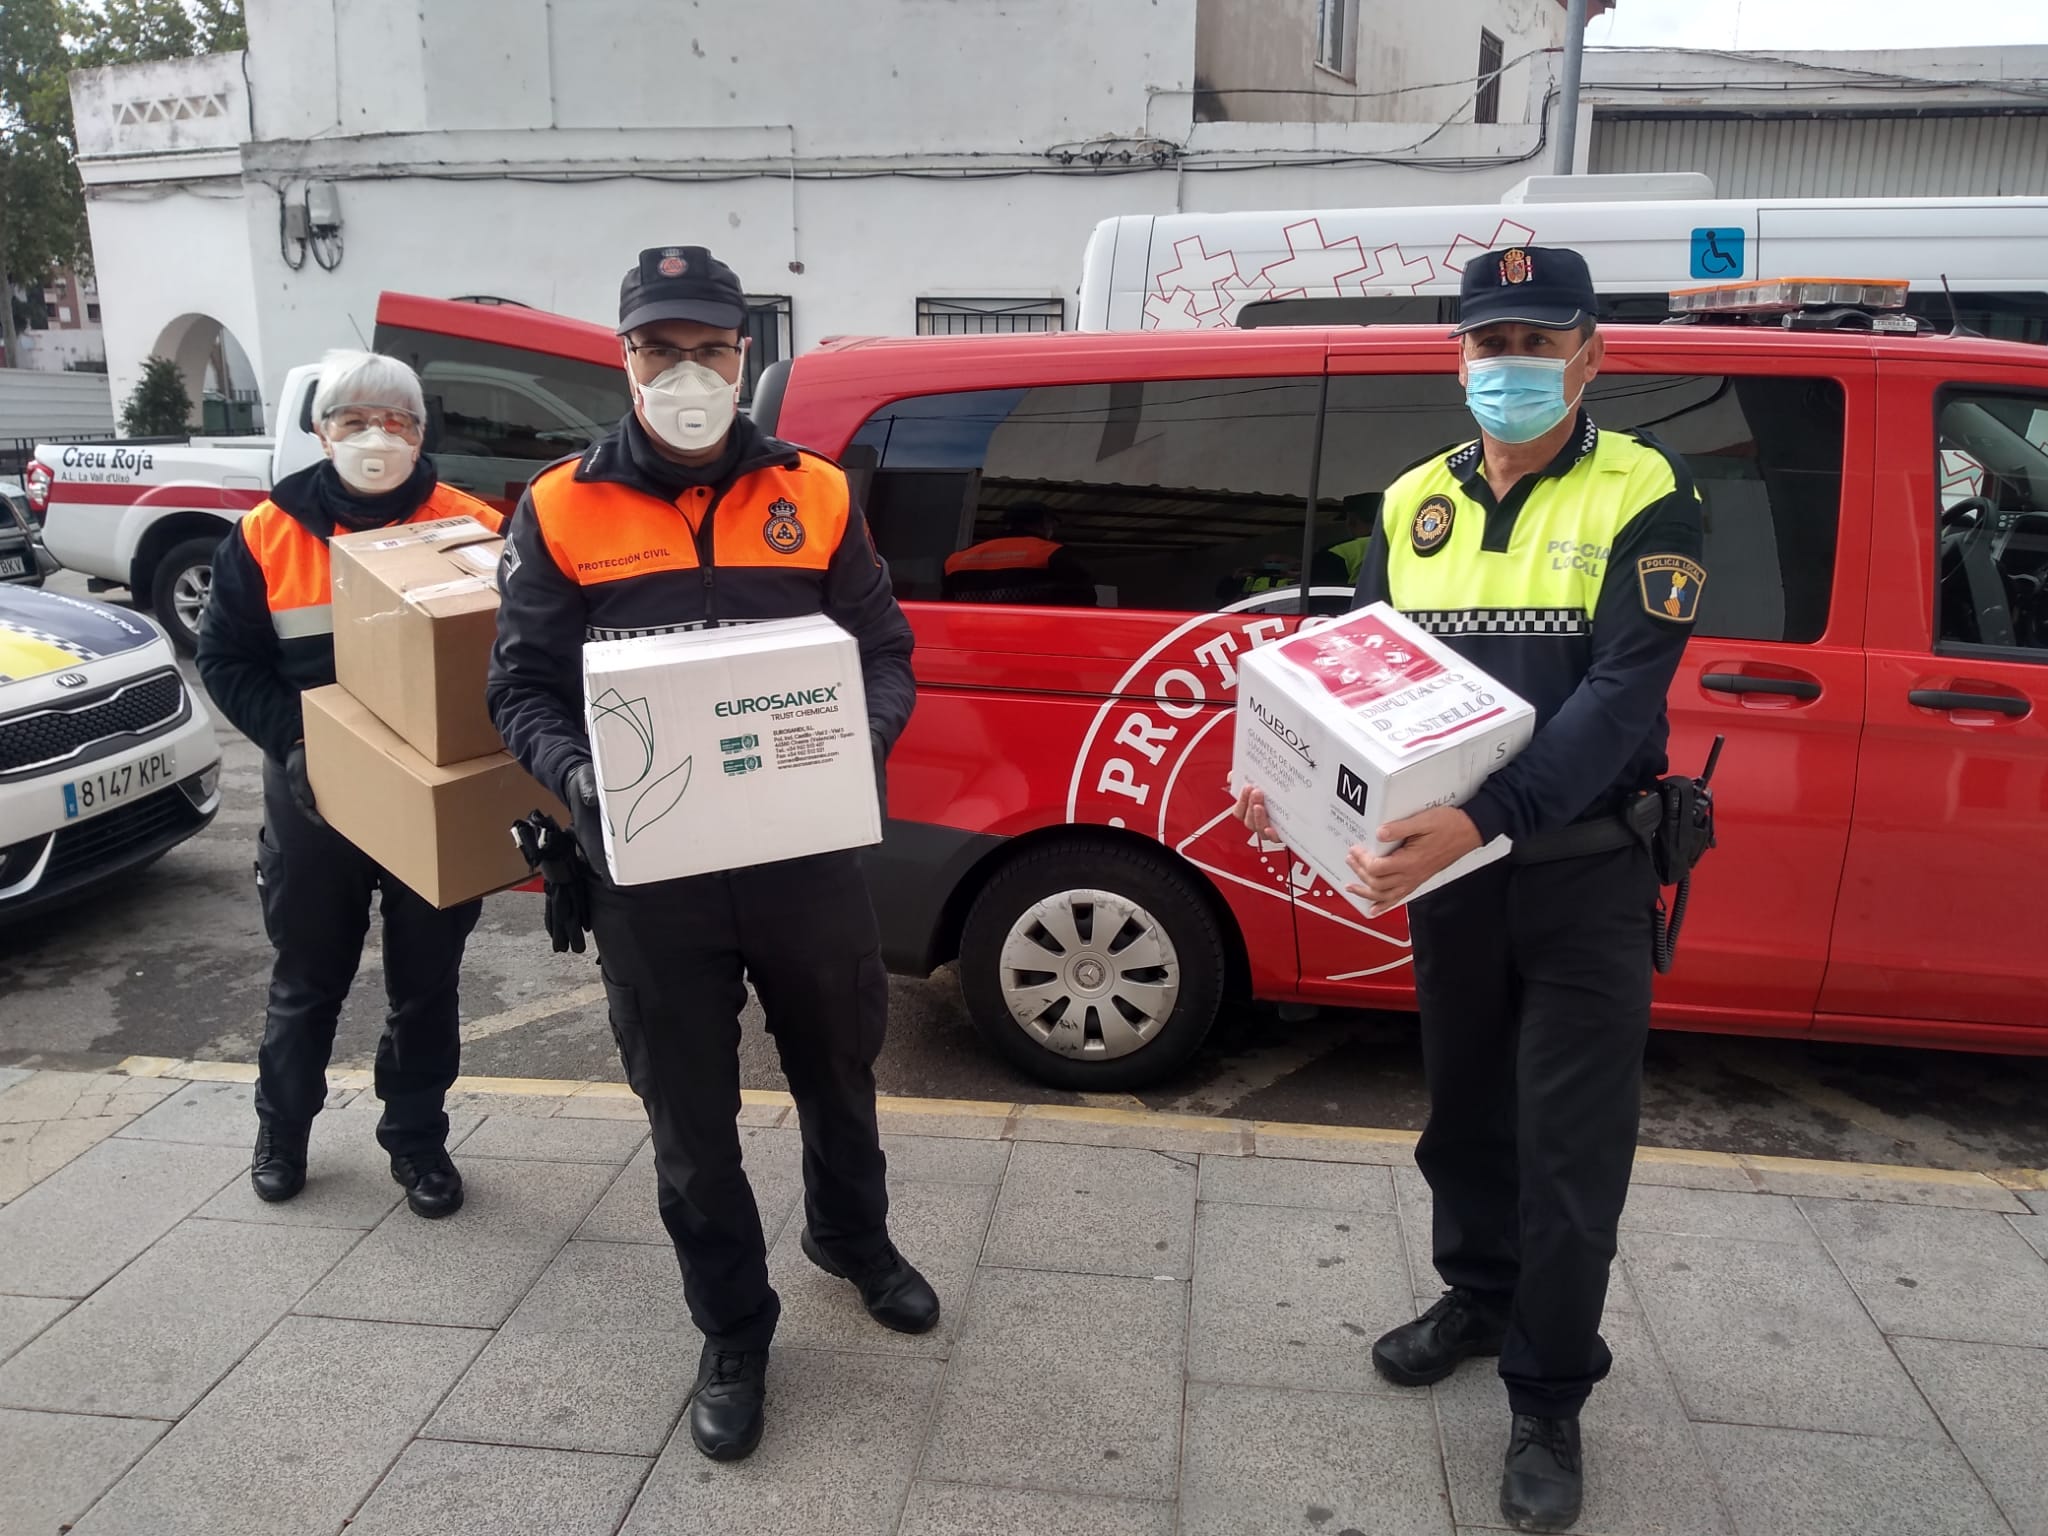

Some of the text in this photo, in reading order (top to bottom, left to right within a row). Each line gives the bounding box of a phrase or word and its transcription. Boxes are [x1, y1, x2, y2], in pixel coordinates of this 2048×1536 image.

[62, 447, 153, 476] Creu Roja
[78, 473, 87, 481] La
[90, 473, 103, 482] Vall
[643, 548, 671, 560] CIVIL
[1552, 556, 1599, 578] LOCAL
[1682, 562, 1701, 580] LOCAL
[58, 674, 87, 687] KIA
[714, 686, 838, 717] EUROSANEX
[771, 705, 839, 721] TRUST CHEMICALS
[1097, 616, 1338, 806] PROTE
[1249, 696, 1311, 758] MUBOX
[81, 753, 172, 807] 8147 KPL
[1342, 773, 1362, 807] M
